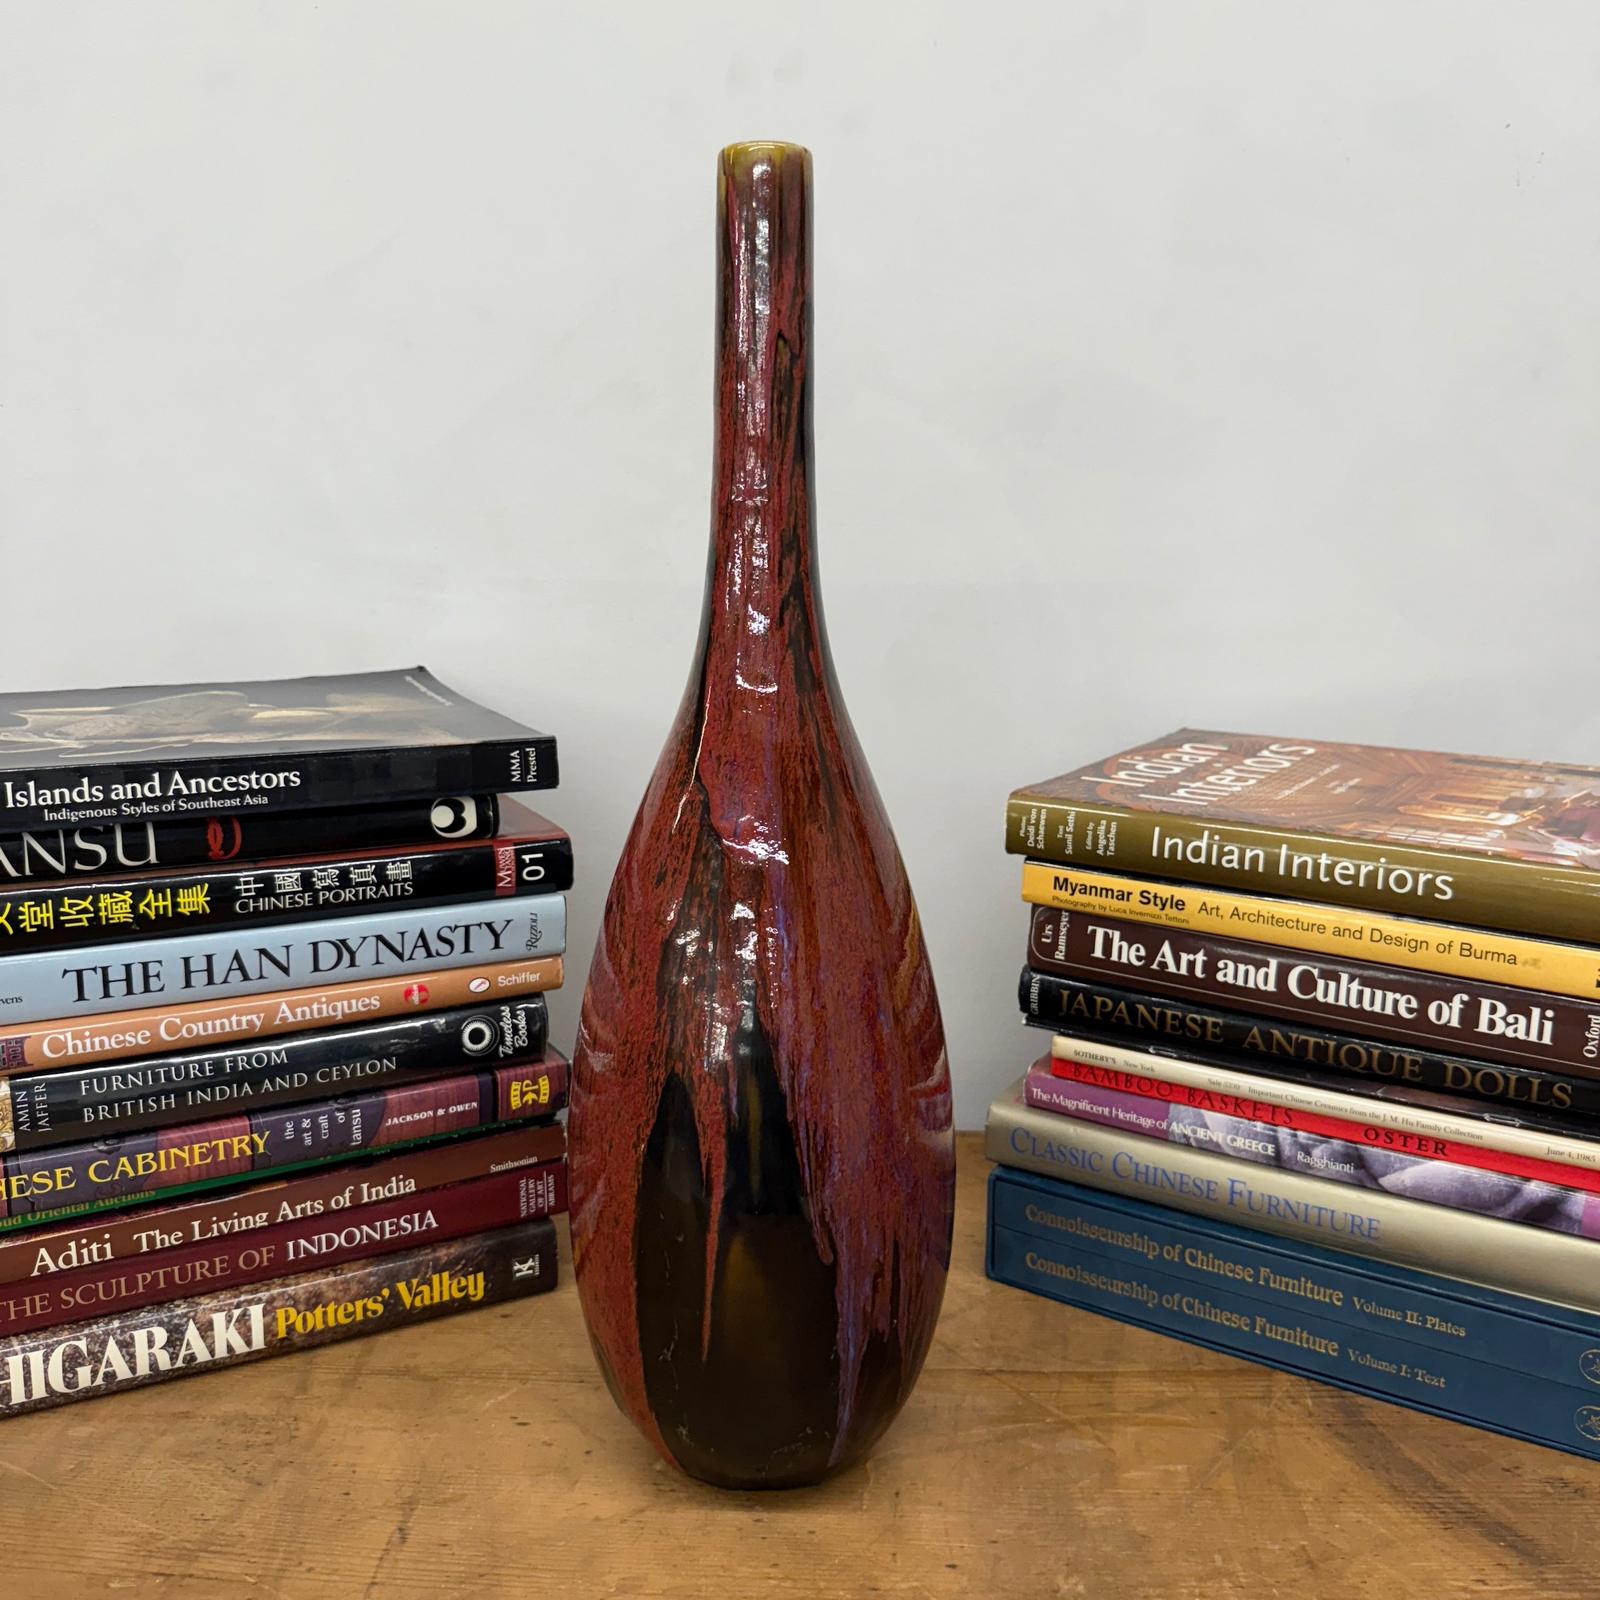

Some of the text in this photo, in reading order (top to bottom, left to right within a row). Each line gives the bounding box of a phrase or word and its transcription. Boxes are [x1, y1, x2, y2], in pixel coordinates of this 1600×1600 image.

[511, 750, 521, 782] MMA
[527, 747, 537, 783] Prestel
[1081, 742, 1228, 787] Indian
[1138, 743, 1316, 805] Interiors
[5, 770, 300, 808] Islands and Ancestors
[44, 794, 268, 822] Indigenous Styles of Southeast Asia
[1027, 825, 1035, 847] Deidi
[1065, 810, 1076, 855] Sunil Sethi
[1087, 822, 1094, 830] by
[1096, 820, 1107, 856] Angelika
[1106, 821, 1117, 856] Taschen
[521, 853, 545, 881] 01
[1151, 826, 1454, 900] Indian Interiors
[235, 881, 413, 914] CHINESE PORTRAITS
[1052, 895, 1096, 910] Photography
[1098, 902, 1106, 912] by
[1109, 906, 1127, 915] Luca
[1041, 923, 1053, 943] Urs
[1053, 876, 1517, 965] Myanmar Style Art, Architecture and Design of Burma
[1055, 911, 1070, 961] Ramseyer
[61, 919, 514, 1003] THE HAN DYNASTY
[498, 972, 541, 987] Schiffer
[1087, 925, 1554, 1045] The Art and Culture of Bali
[42, 995, 381, 1059] Chinese Country Antiques
[500, 1005, 513, 1058] Timeless
[514, 1010, 528, 1048] Books
[1059, 988, 1572, 1110] JAPANESE ANTIQUE DOLLS
[81, 1049, 288, 1095] FURNITURE FROM
[83, 1056, 397, 1123] BRITISH INDIA AND CEYLON
[15, 1090, 31, 1132] AMIN
[34, 1082, 52, 1132] JAFFER
[1072, 1063, 1293, 1124] BAMBOO BASKETS
[284, 1120, 294, 1140] the
[302, 1118, 312, 1146] art &
[318, 1114, 329, 1139] craft
[335, 1111, 345, 1123] of
[350, 1108, 362, 1146] tansu
[386, 1101, 478, 1126] JACKSON & OWEN
[1031, 1088, 1276, 1156] The Magnificent Heritage of ANCIENT GREECE
[1349, 1107, 1366, 1119] from
[1368, 1110, 1381, 1121] the
[1416, 1120, 1442, 1133] Family
[1443, 1125, 1483, 1140] Collection
[88, 1130, 271, 1183] CABINETRY
[1363, 1127, 1448, 1156] OSTER
[490, 1155, 538, 1173] Smithsonian
[1296, 1151, 1354, 1174] Ragghianti
[1010, 1127, 1381, 1241] CLASSIC CHINESE FURNITURE
[30, 1175, 416, 1277] Aditi The Living Arts of India
[60, 1256, 231, 1310] SCULPTURE
[238, 1246, 276, 1270] OF
[287, 1210, 439, 1261] INDONESIA
[1025, 1204, 1466, 1337] Connoisseurship of Chinese Furniture Volume II: Plates
[396, 1271, 485, 1310] Valley
[1025, 1251, 1158, 1308] Connoisseurship
[1162, 1292, 1181, 1308] of
[1181, 1297, 1250, 1330] Chinese
[1254, 1317, 1339, 1356] Furniture
[1348, 1348, 1397, 1374] Volume
[1414, 1369, 1446, 1388] Text
